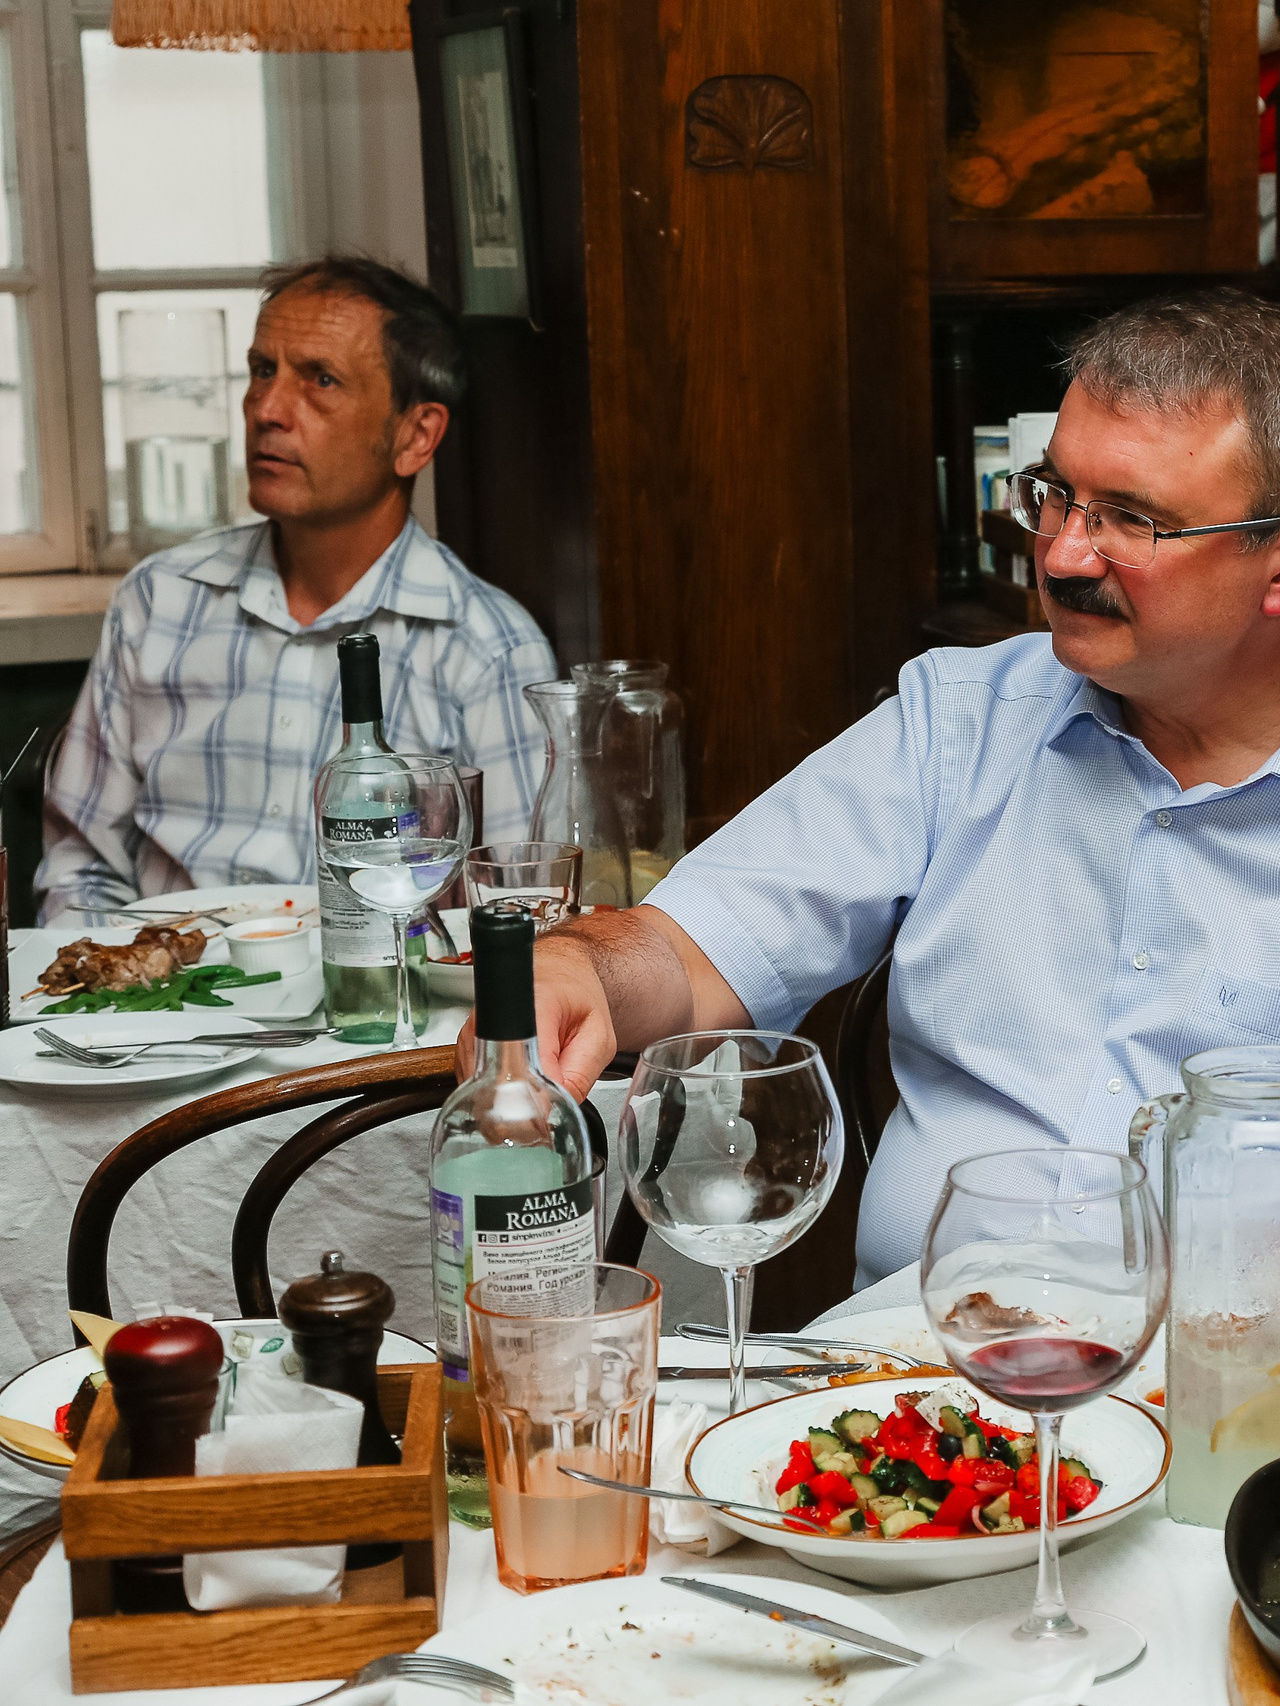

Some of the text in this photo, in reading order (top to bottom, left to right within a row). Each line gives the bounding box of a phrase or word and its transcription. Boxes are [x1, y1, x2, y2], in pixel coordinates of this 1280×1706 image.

[335, 821, 364, 831] ALMA
[329, 827, 375, 841] ROMANA
[522, 1191, 567, 1211] ALMA
[506, 1201, 579, 1231] ROMANA
[539, 1279, 558, 1291] Год
